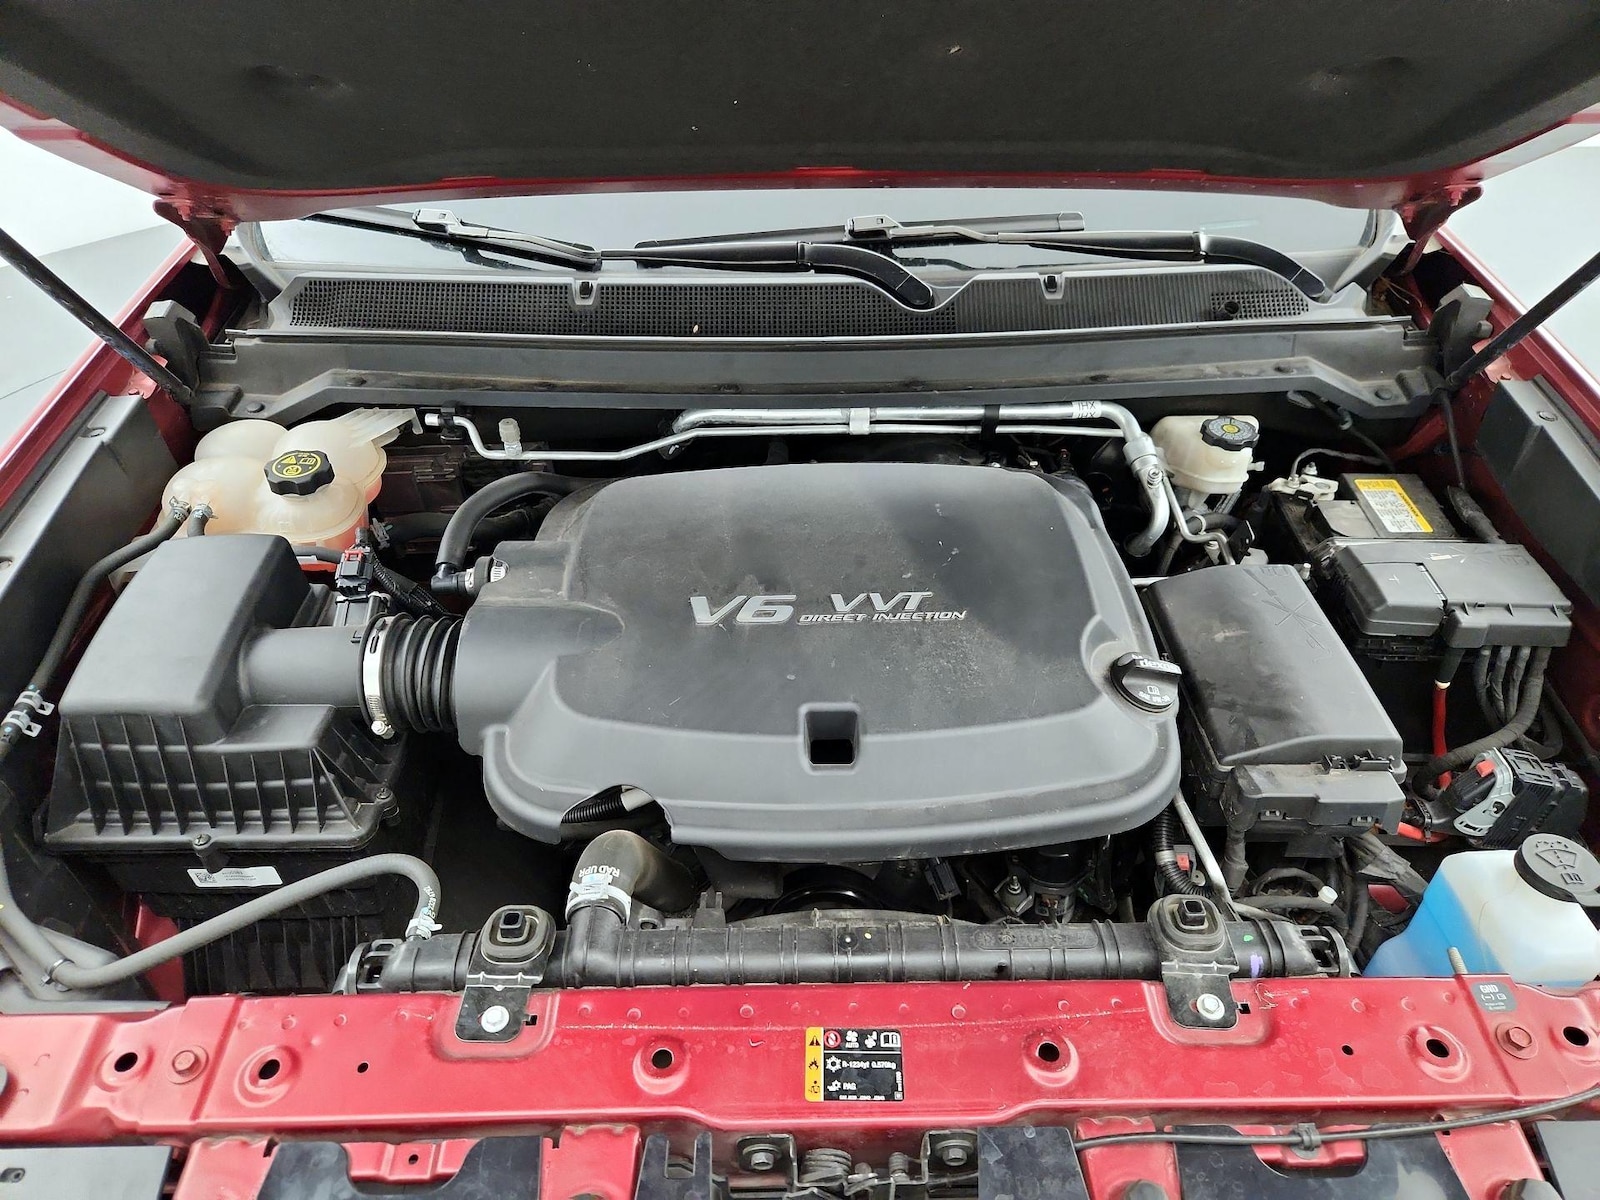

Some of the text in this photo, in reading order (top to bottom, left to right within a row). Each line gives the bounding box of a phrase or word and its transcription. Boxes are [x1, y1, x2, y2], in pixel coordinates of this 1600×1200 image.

[830, 591, 933, 613] VVT
[690, 594, 797, 625] V6
[800, 610, 967, 623] DIRECT INJECTION
[578, 865, 620, 878] RAD UPR
[1480, 984, 1499, 993] GND
[842, 1061, 870, 1070] R-1234yf
[843, 1082, 857, 1091] PAG
